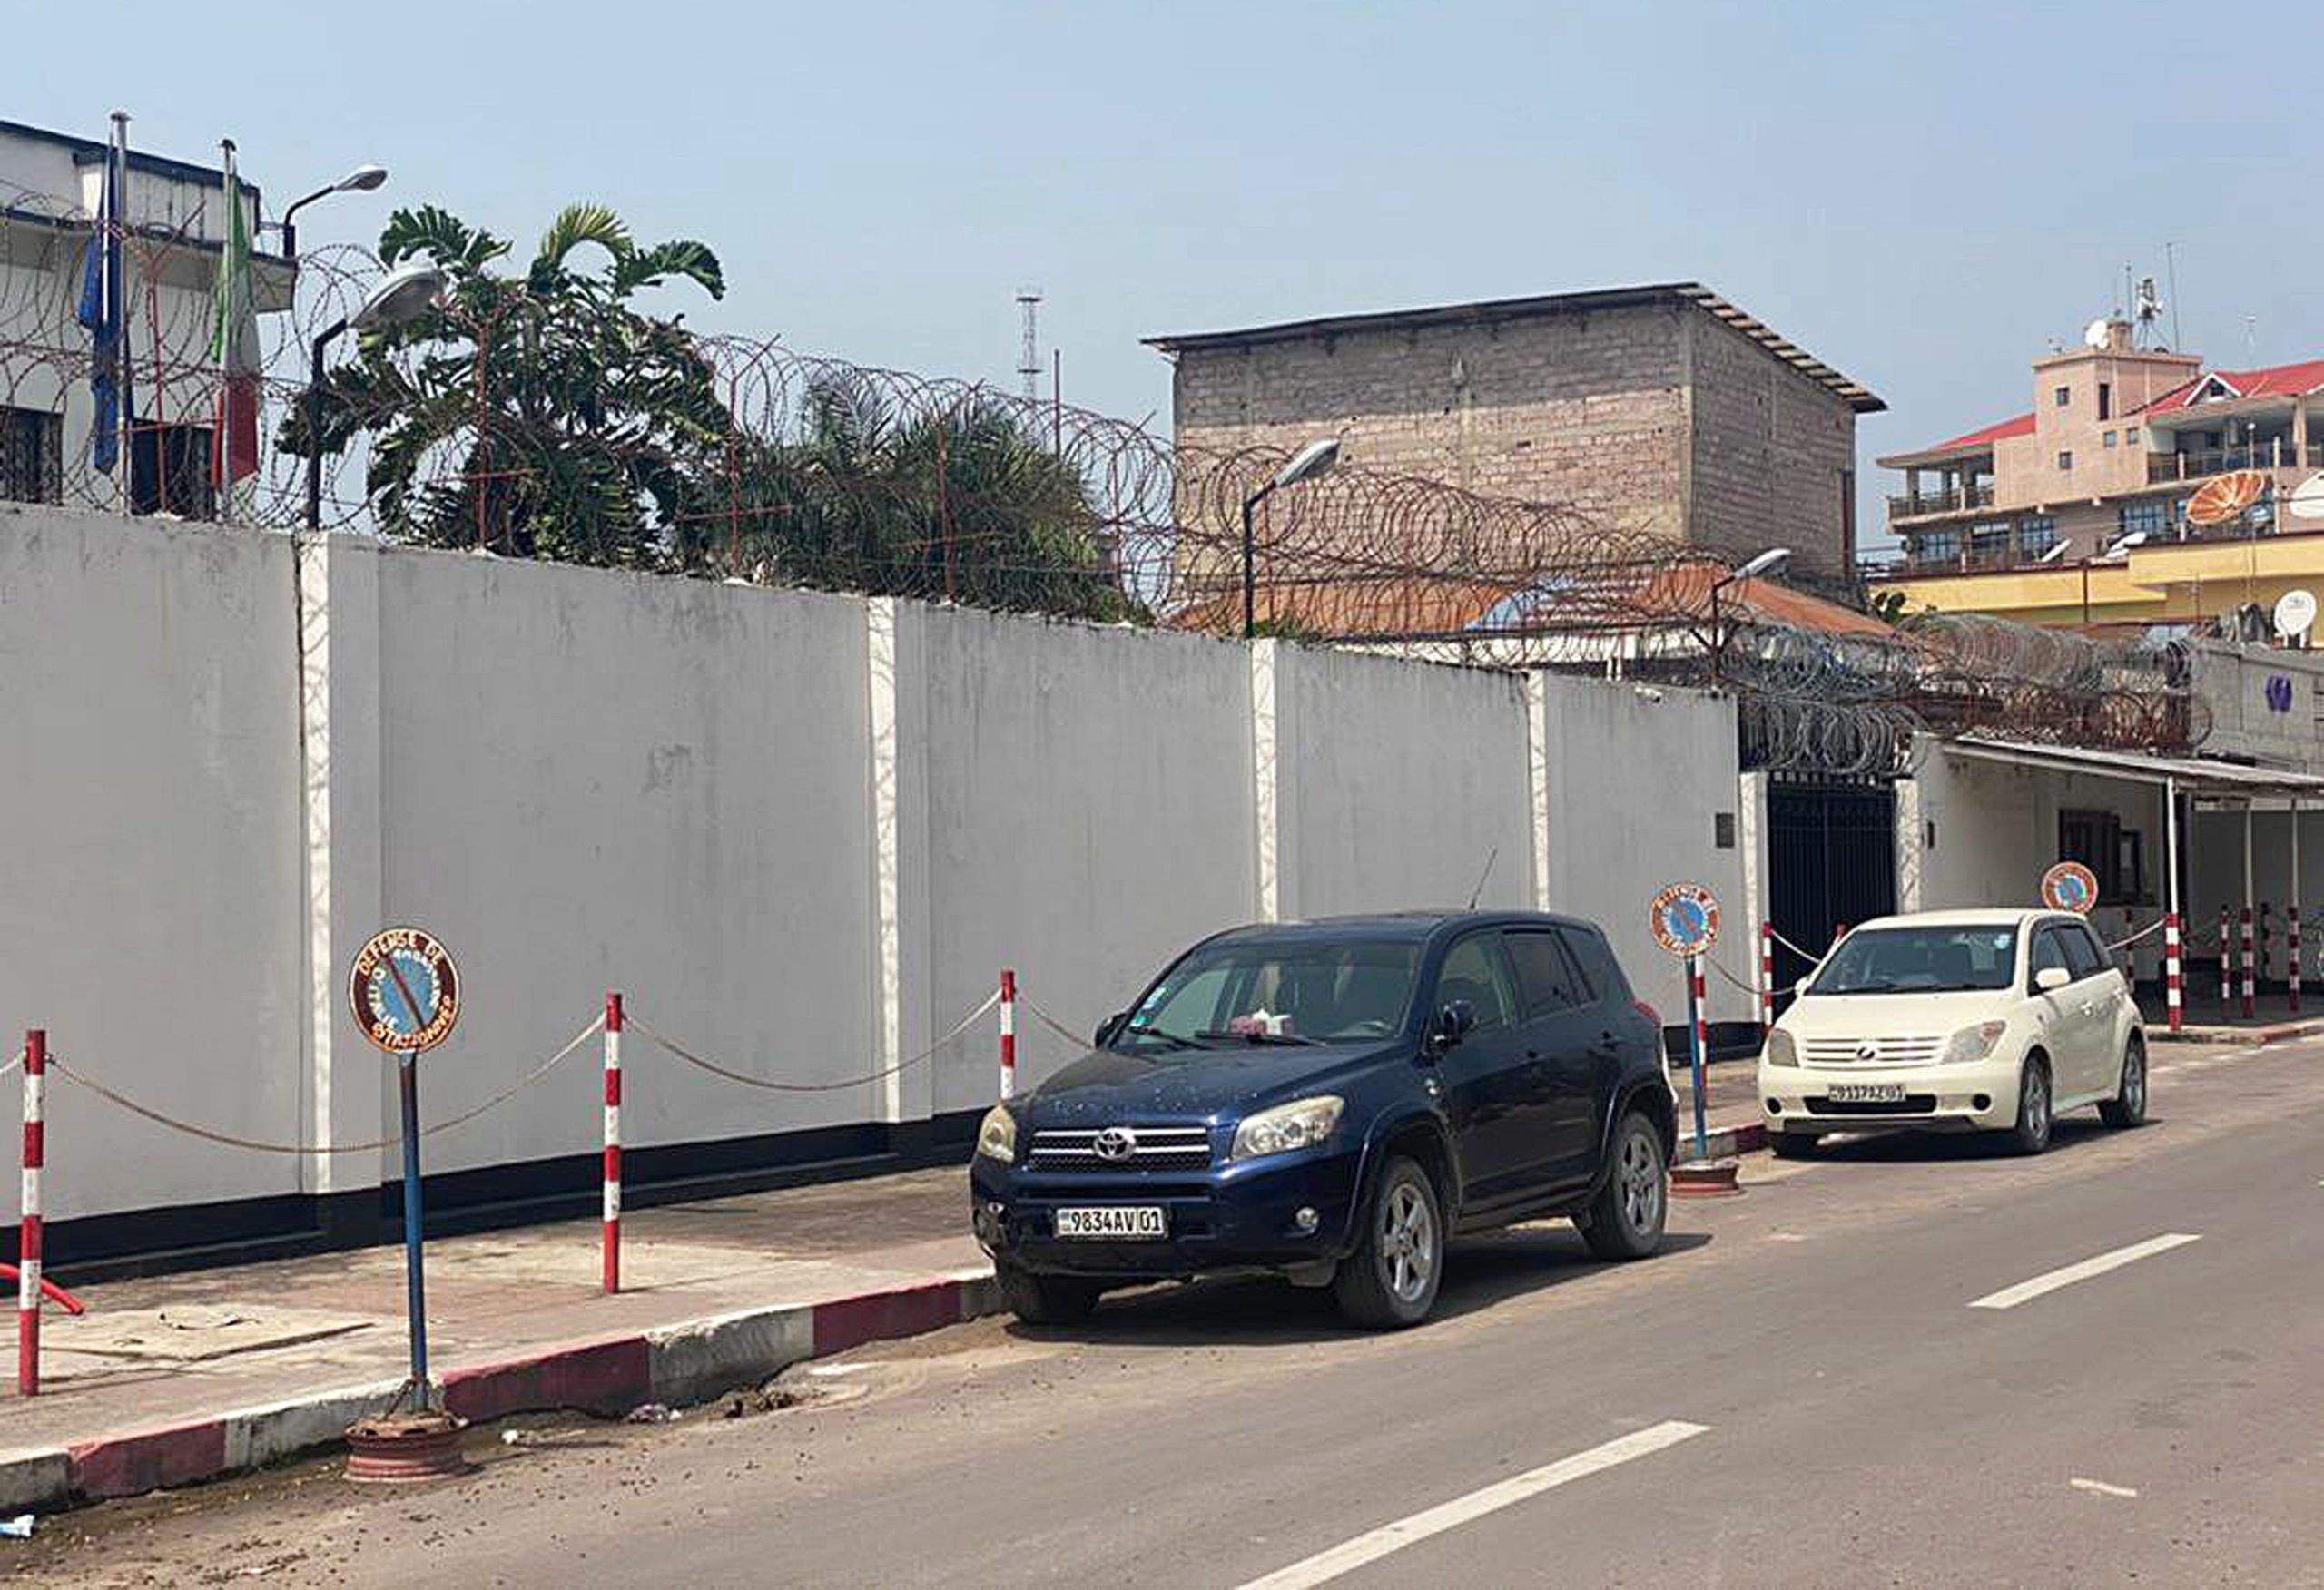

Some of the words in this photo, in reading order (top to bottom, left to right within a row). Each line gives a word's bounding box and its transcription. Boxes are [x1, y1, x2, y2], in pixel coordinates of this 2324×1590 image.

[358, 929, 418, 976] DEFENSE
[424, 940, 444, 965] DE
[1071, 1210, 1135, 1232] 9834AV
